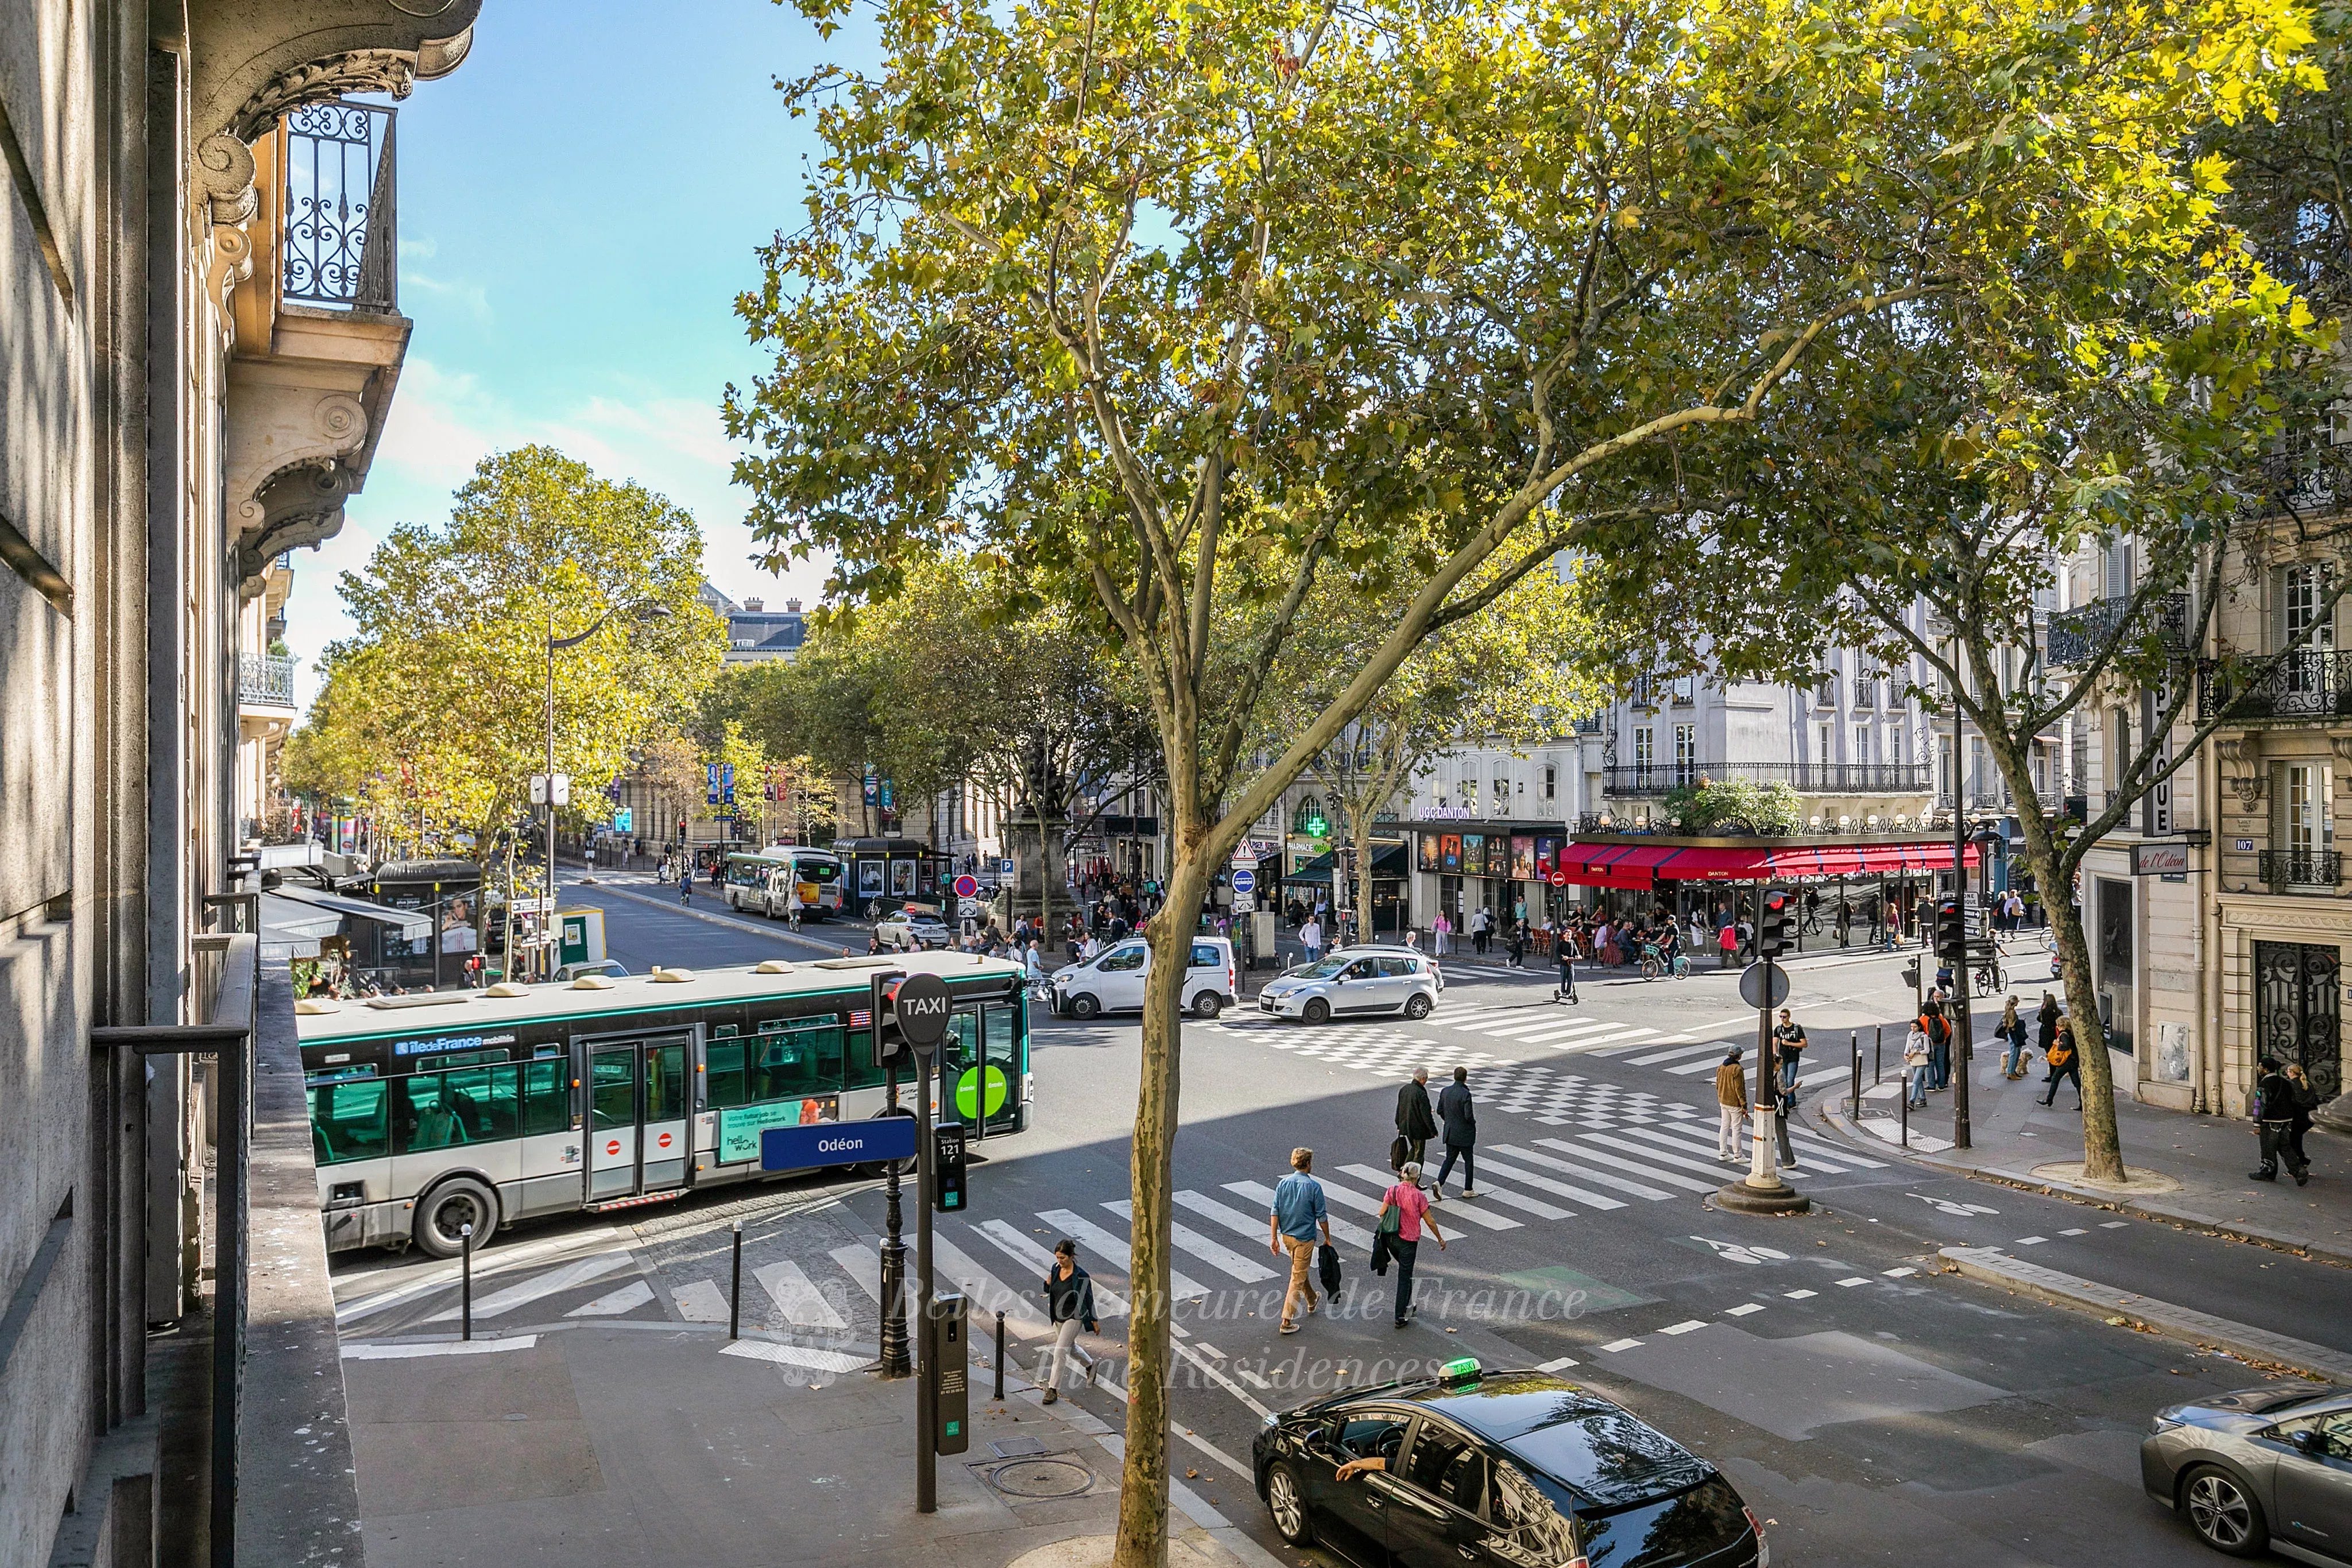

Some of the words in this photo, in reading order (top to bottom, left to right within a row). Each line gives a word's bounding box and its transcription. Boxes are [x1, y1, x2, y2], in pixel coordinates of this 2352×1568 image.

[1419, 807, 1436, 818] UGC
[1437, 807, 1470, 819] DANTON
[1713, 816, 1750, 830] DANTON
[1287, 842, 1314, 852] PHARMACIE
[1314, 842, 1331, 853] ODÉON
[2237, 840, 2252, 850] 107
[2139, 855, 2148, 868] de
[2150, 850, 2185, 868] l'Odéon
[1004, 862, 1011, 871] P
[903, 997, 947, 1016] TAXI
[482, 1034, 516, 1046] mobilités
[757, 1116, 786, 1125] Hellowork
[818, 1137, 863, 1152] Odéon
[941, 1144, 959, 1155] 121
[1453, 1361, 1476, 1373] TAXI
